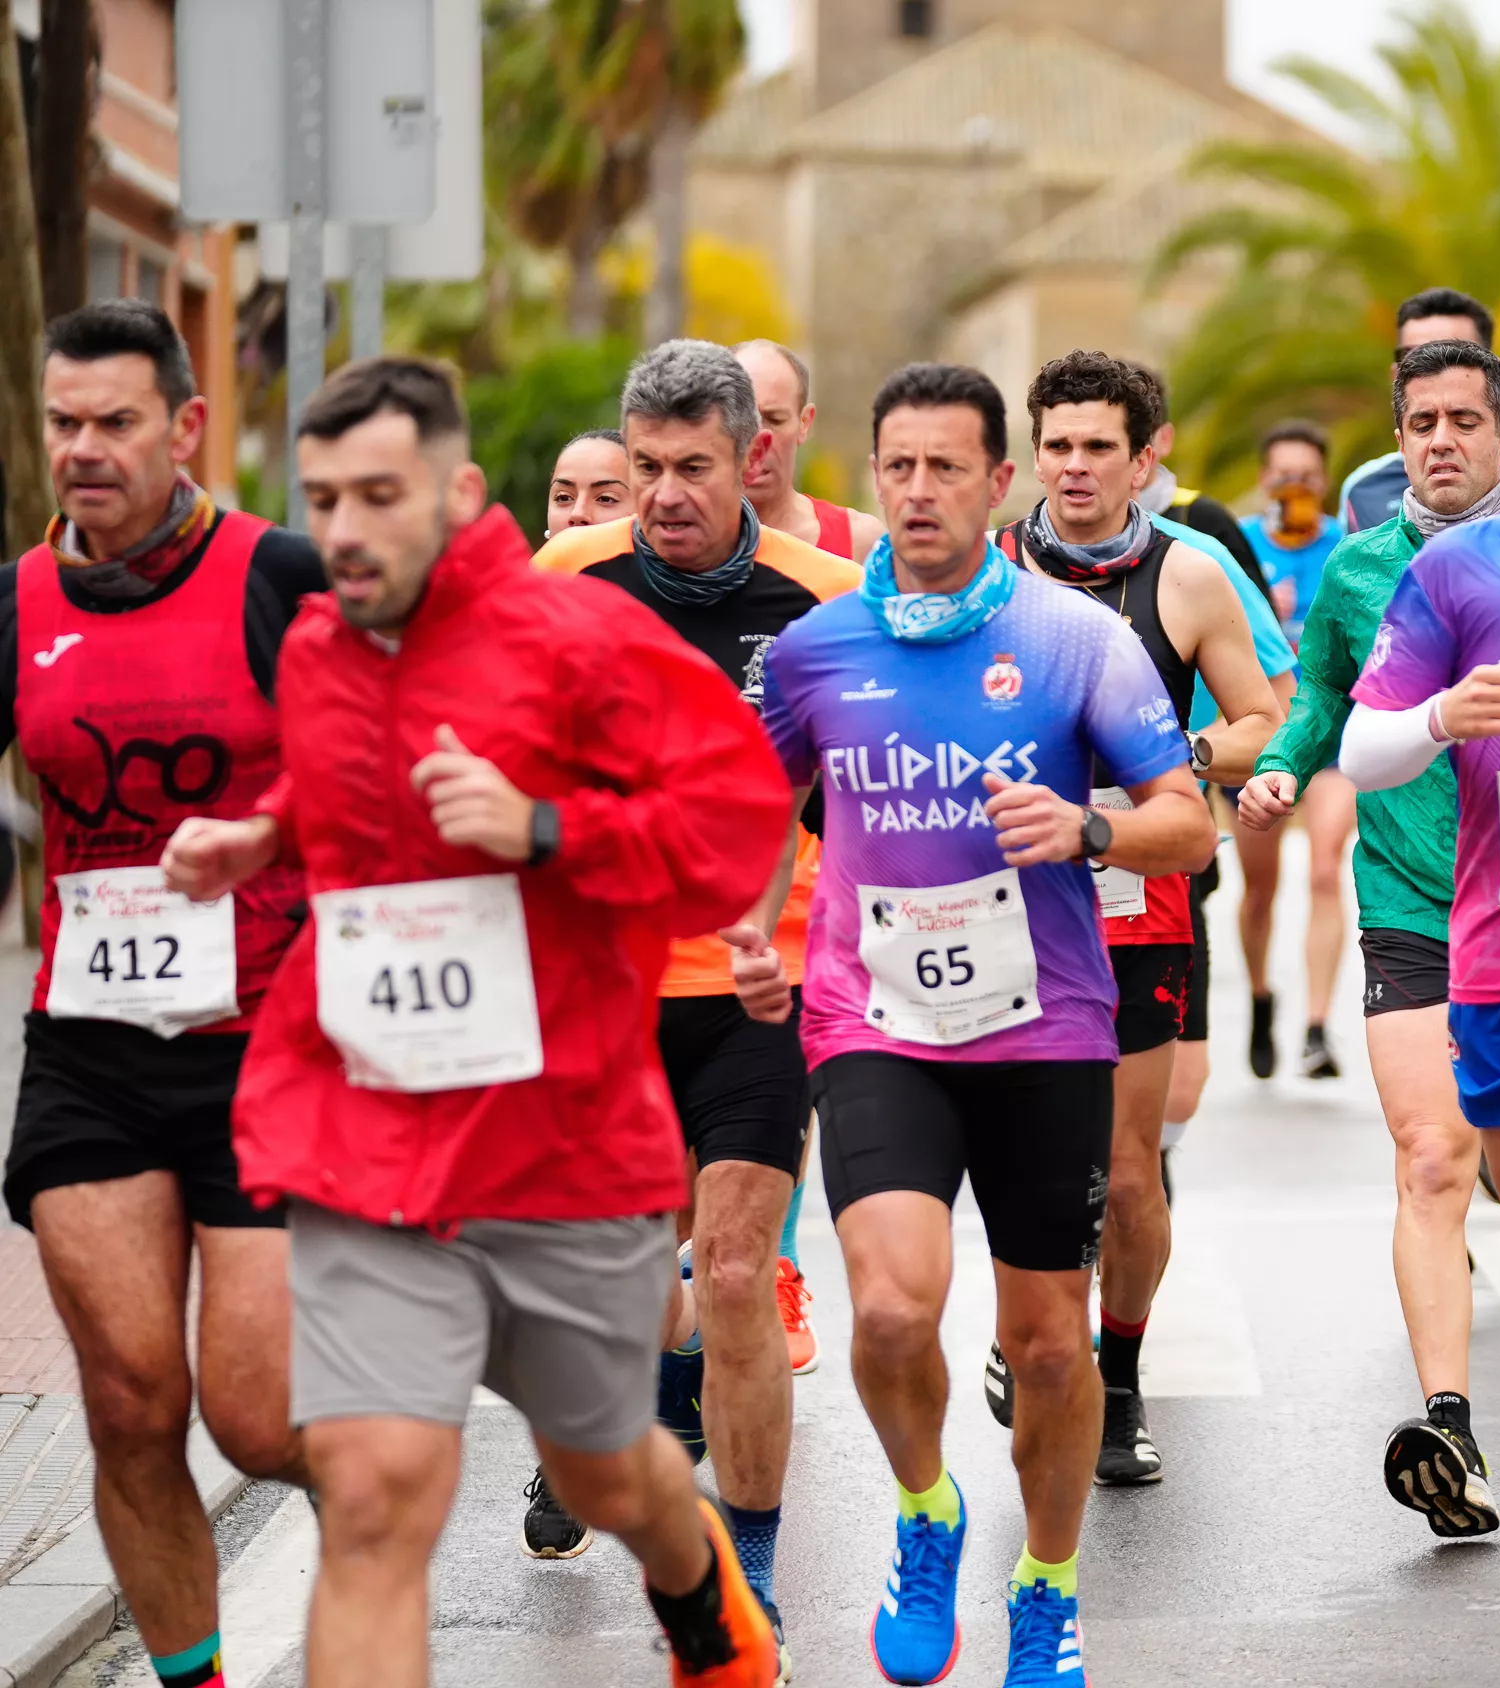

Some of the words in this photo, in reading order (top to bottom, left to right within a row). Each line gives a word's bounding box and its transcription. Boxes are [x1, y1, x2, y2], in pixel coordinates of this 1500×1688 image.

[826, 731, 1038, 793] FILÍPIDES
[861, 796, 1000, 832] PARADA
[88, 933, 183, 982] 412
[916, 945, 974, 989] 65
[369, 960, 473, 1014] 410
